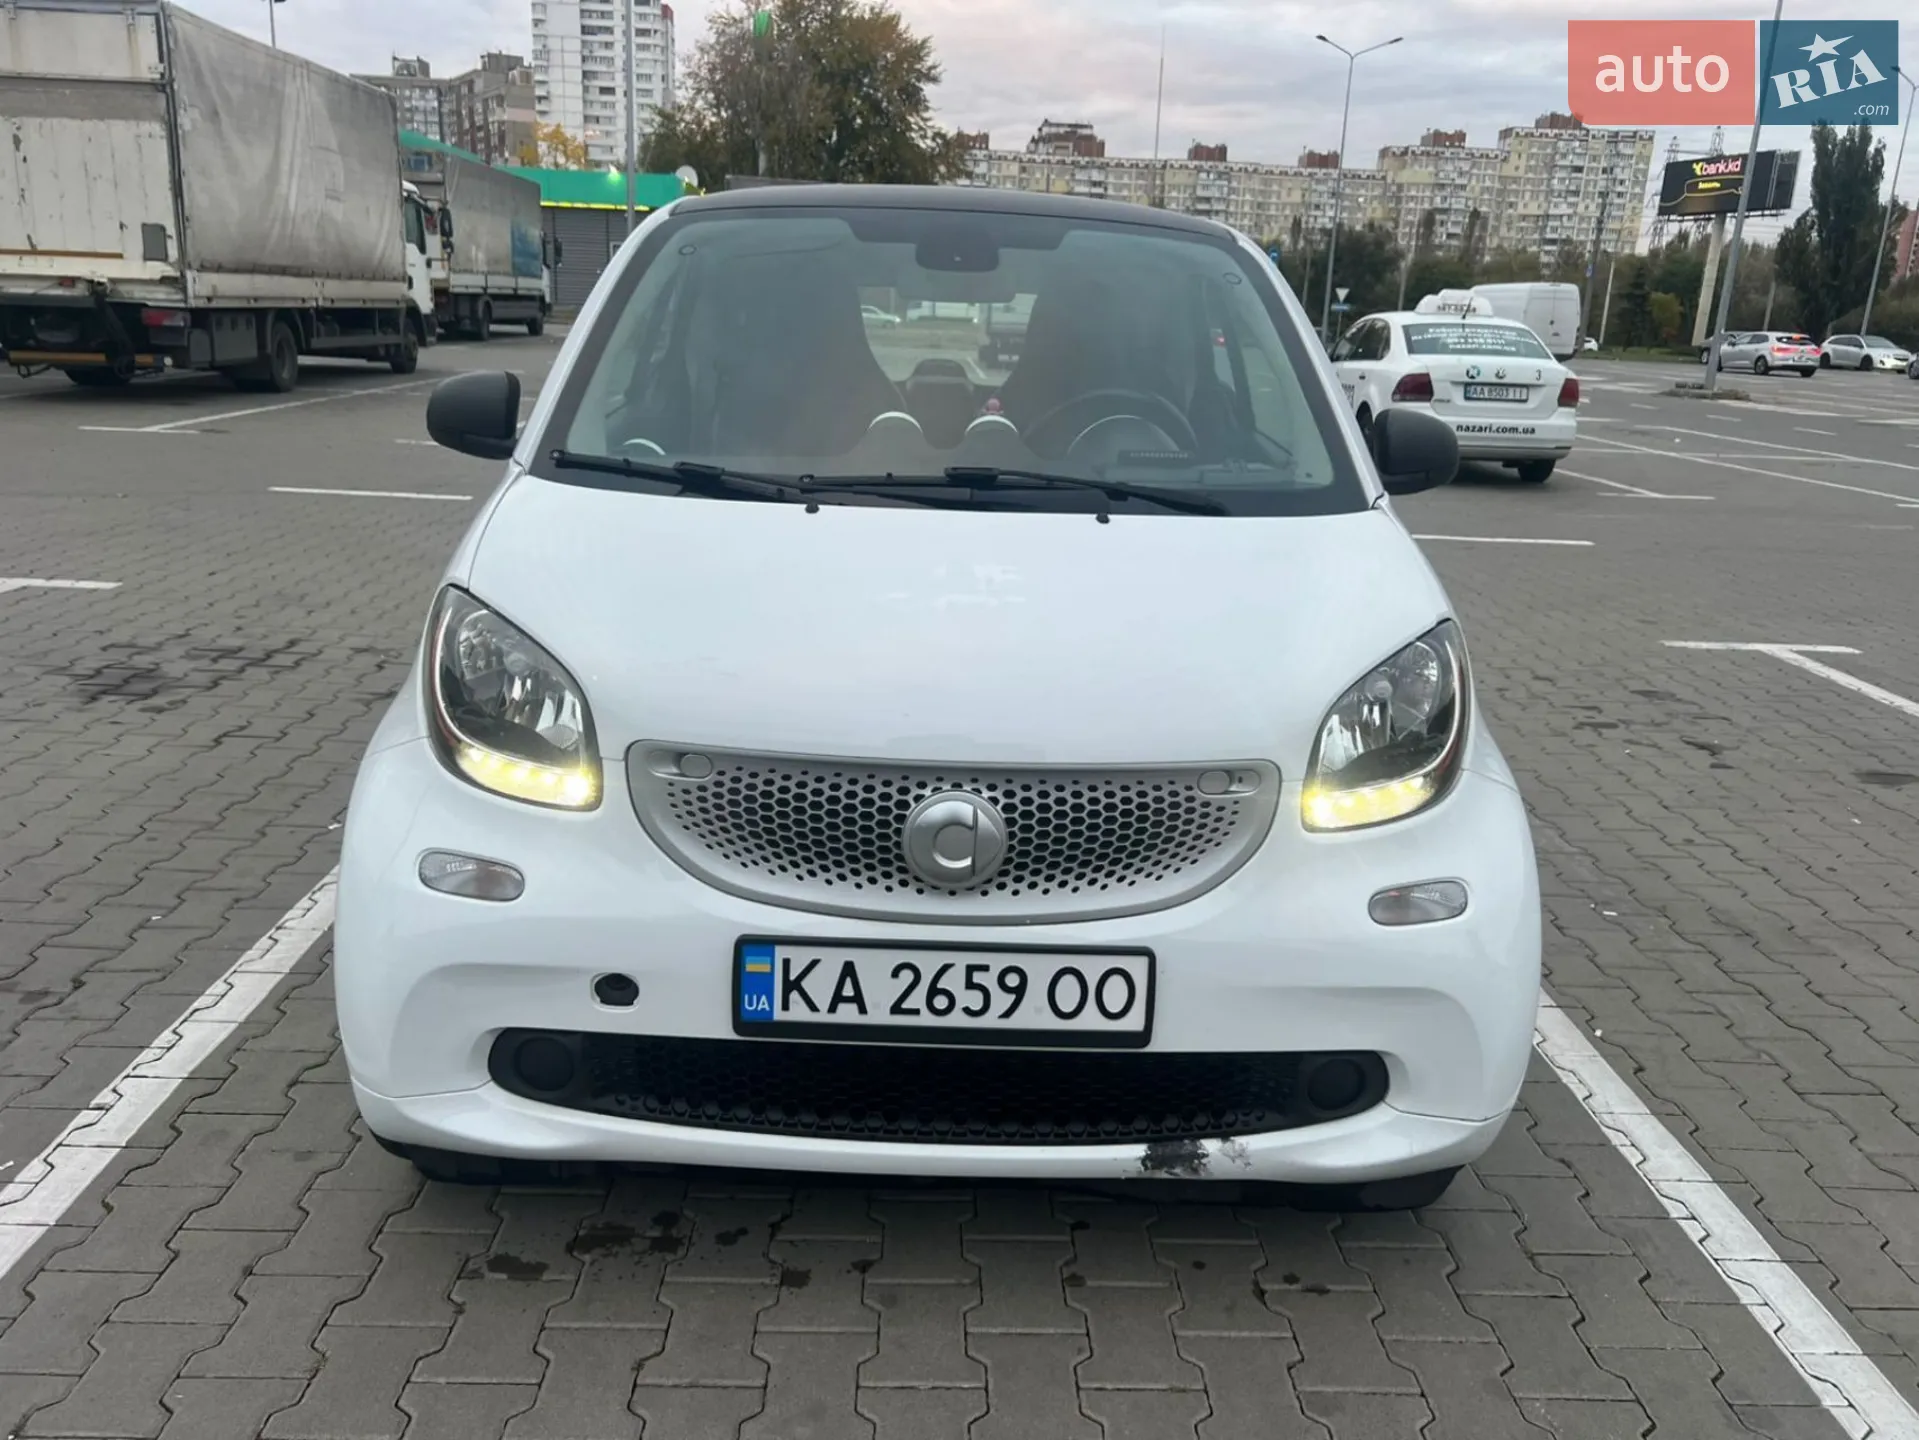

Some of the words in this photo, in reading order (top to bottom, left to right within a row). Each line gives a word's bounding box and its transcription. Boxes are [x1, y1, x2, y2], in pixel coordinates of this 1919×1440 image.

[1456, 423, 1536, 435] nazari.com.ua
[781, 957, 868, 1015] KA
[889, 961, 1029, 1019] 2659
[744, 994, 770, 1011] UA
